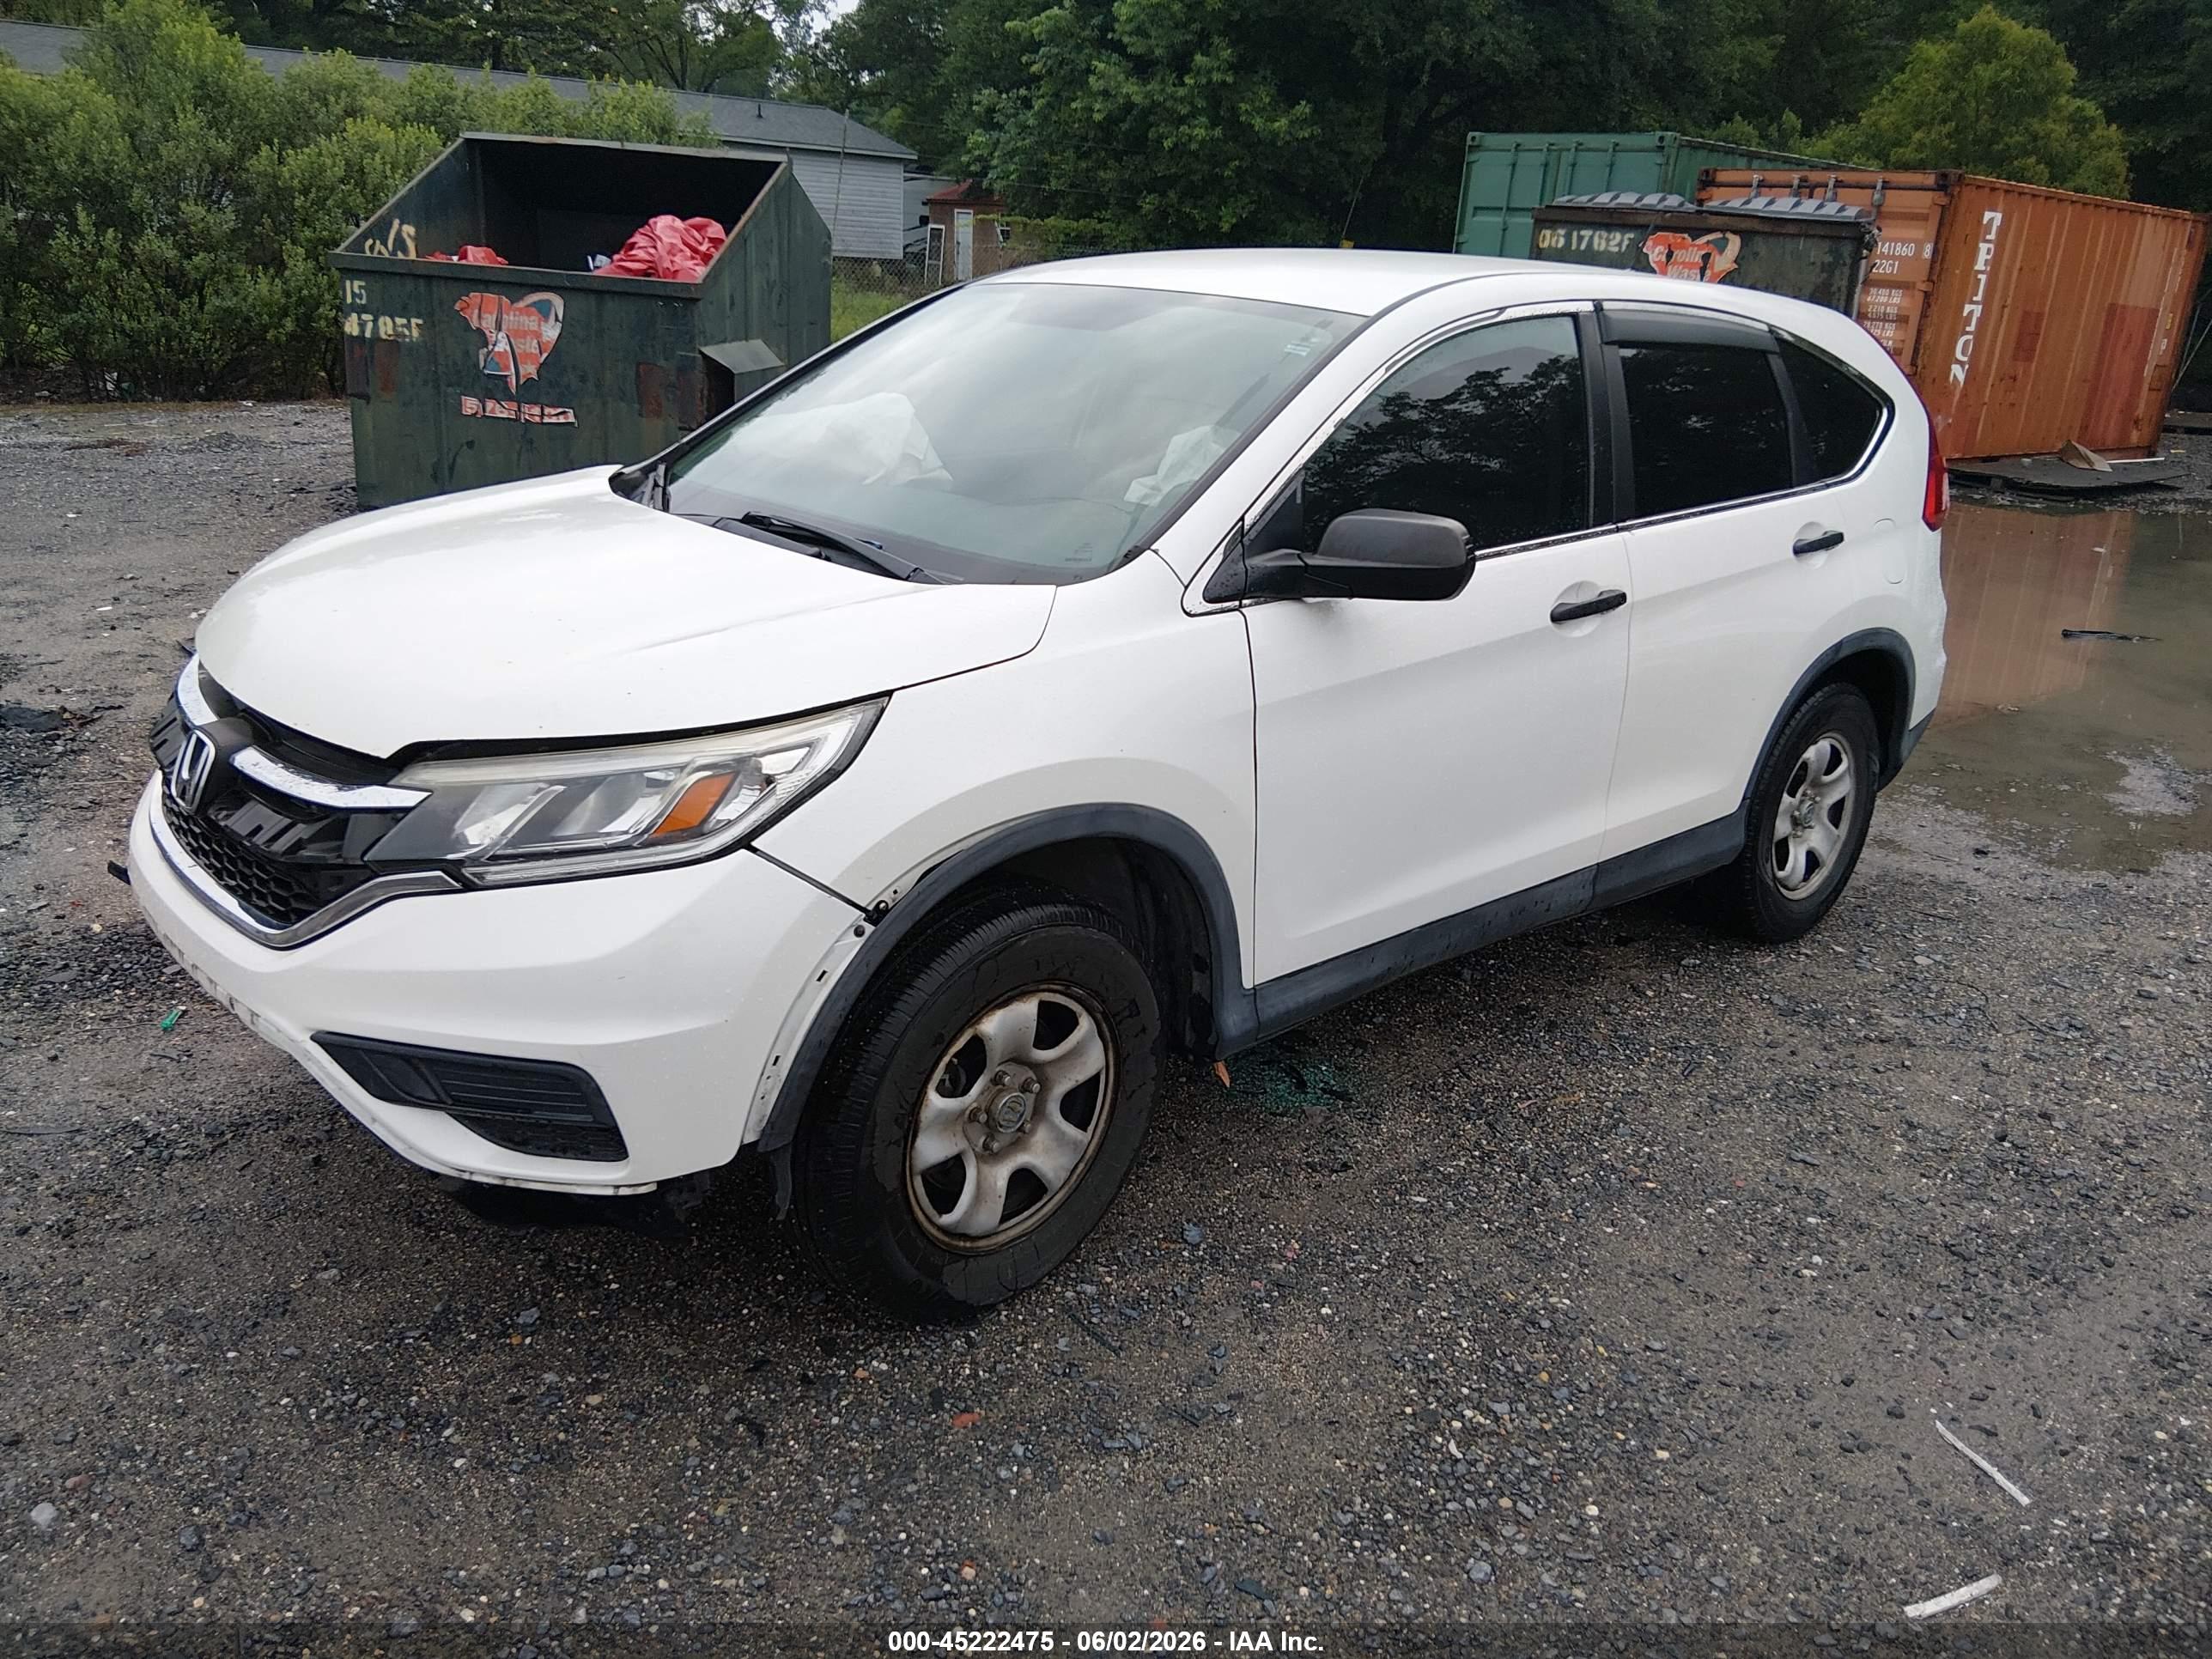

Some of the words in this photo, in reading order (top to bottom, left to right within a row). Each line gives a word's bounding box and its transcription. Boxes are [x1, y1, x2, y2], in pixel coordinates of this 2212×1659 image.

[1876, 241, 1916, 257] 141860
[1923, 244, 1932, 258] 8
[1872, 259, 1899, 274] 22G1
[345, 279, 367, 305] 15
